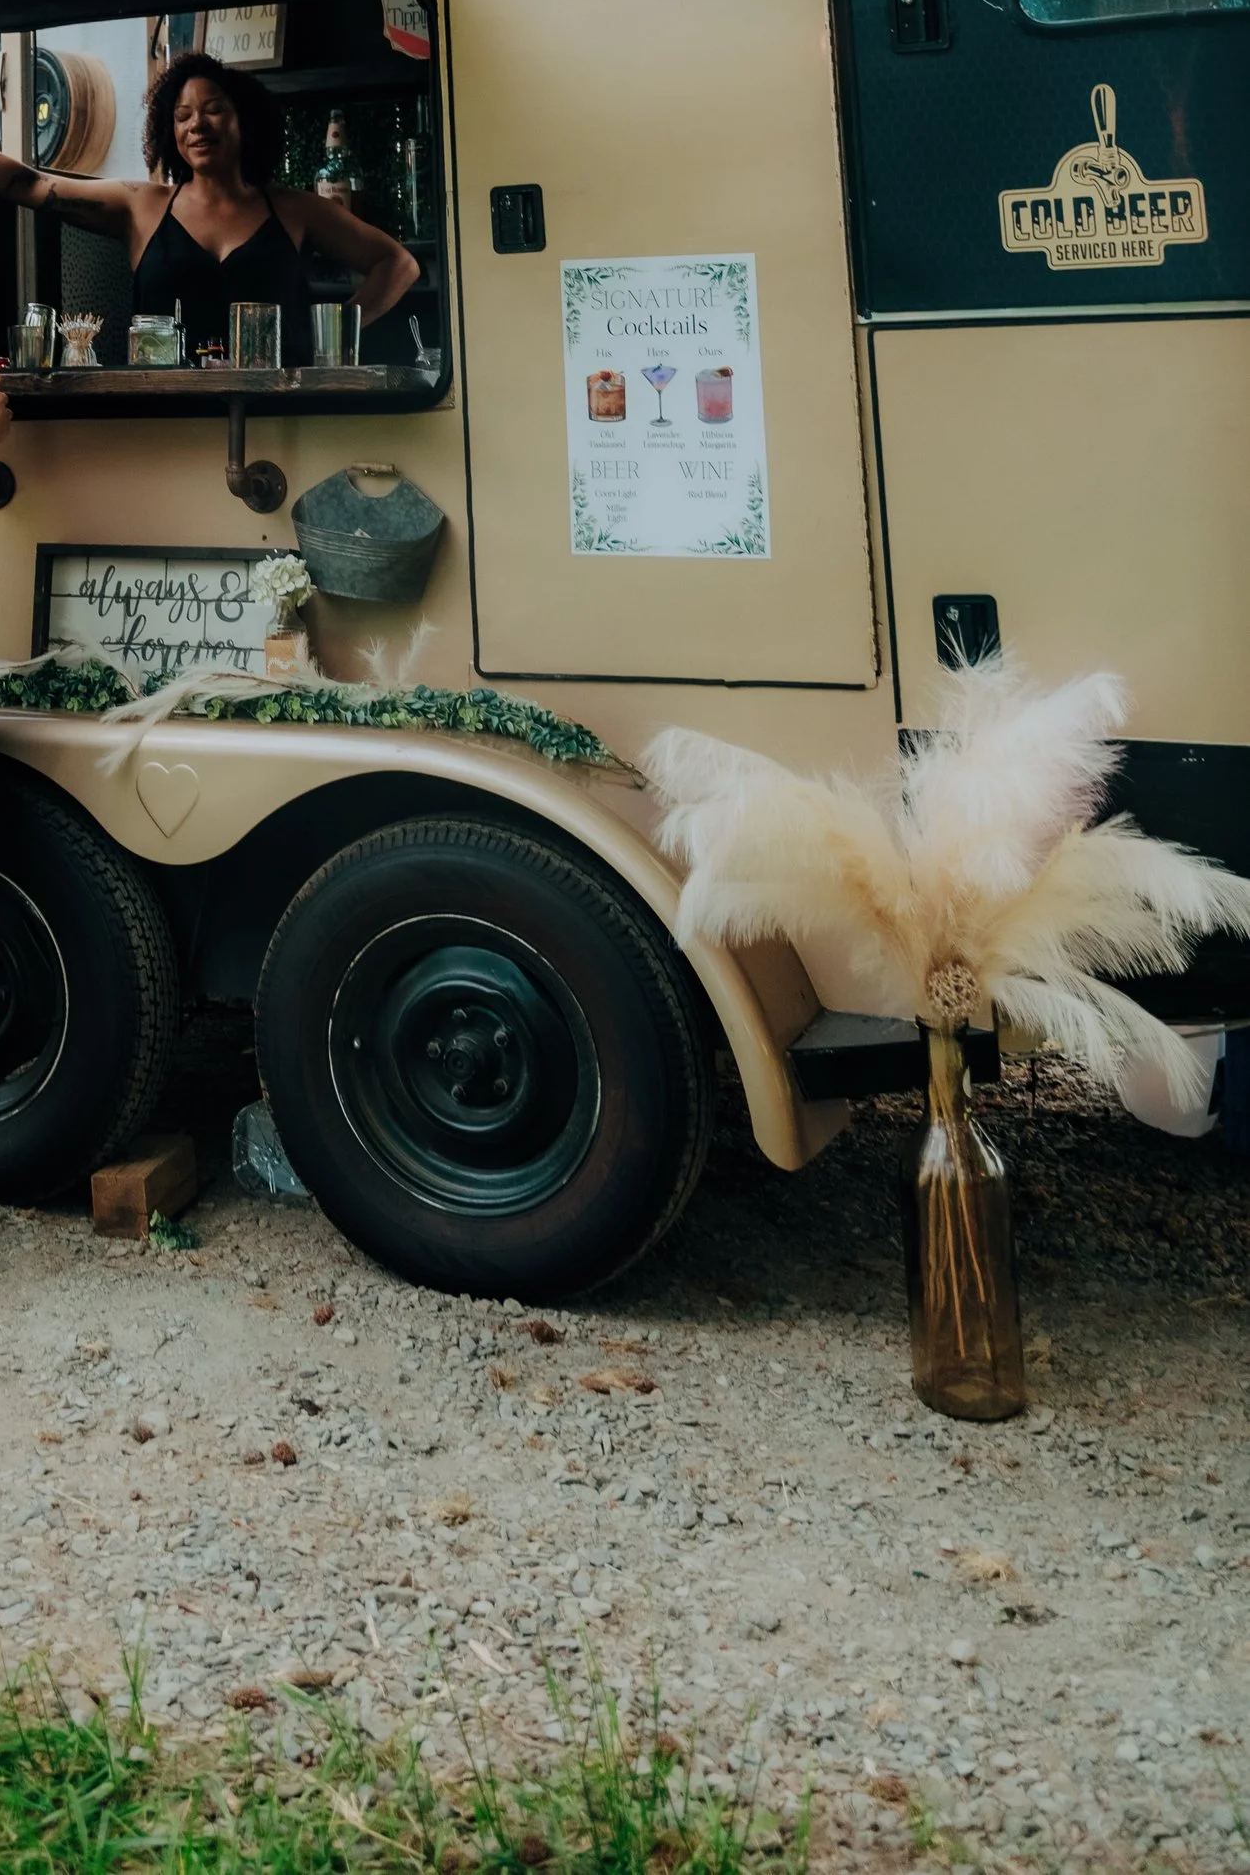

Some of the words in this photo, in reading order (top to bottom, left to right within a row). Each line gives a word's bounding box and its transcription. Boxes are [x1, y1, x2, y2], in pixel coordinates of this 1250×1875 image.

[233, 32, 251, 52] XO
[1011, 196, 1097, 241] COLD
[1104, 191, 1195, 236] BEER
[1056, 241, 1117, 261] SERVICED
[1123, 240, 1155, 258] HERE
[591, 287, 721, 310] SIGNATURE
[607, 314, 707, 337] Cocktails
[596, 348, 612, 358] His
[647, 347, 670, 357] Hers
[698, 346, 723, 357] Ours
[600, 430, 614, 439] Old
[647, 430, 680, 439] Lavender
[701, 430, 734, 439] Hibiscus
[590, 439, 626, 448] Fashioned
[699, 440, 737, 450] Margarita
[590, 460, 640, 479] BEER
[678, 460, 735, 480] WINE
[594, 489, 616, 498] Coors
[618, 489, 637, 500] Light
[688, 490, 703, 499] Red
[705, 490, 727, 499] Blend
[607, 514, 627, 523] Light
[79, 564, 209, 624] always
[214, 570, 251, 623] &
